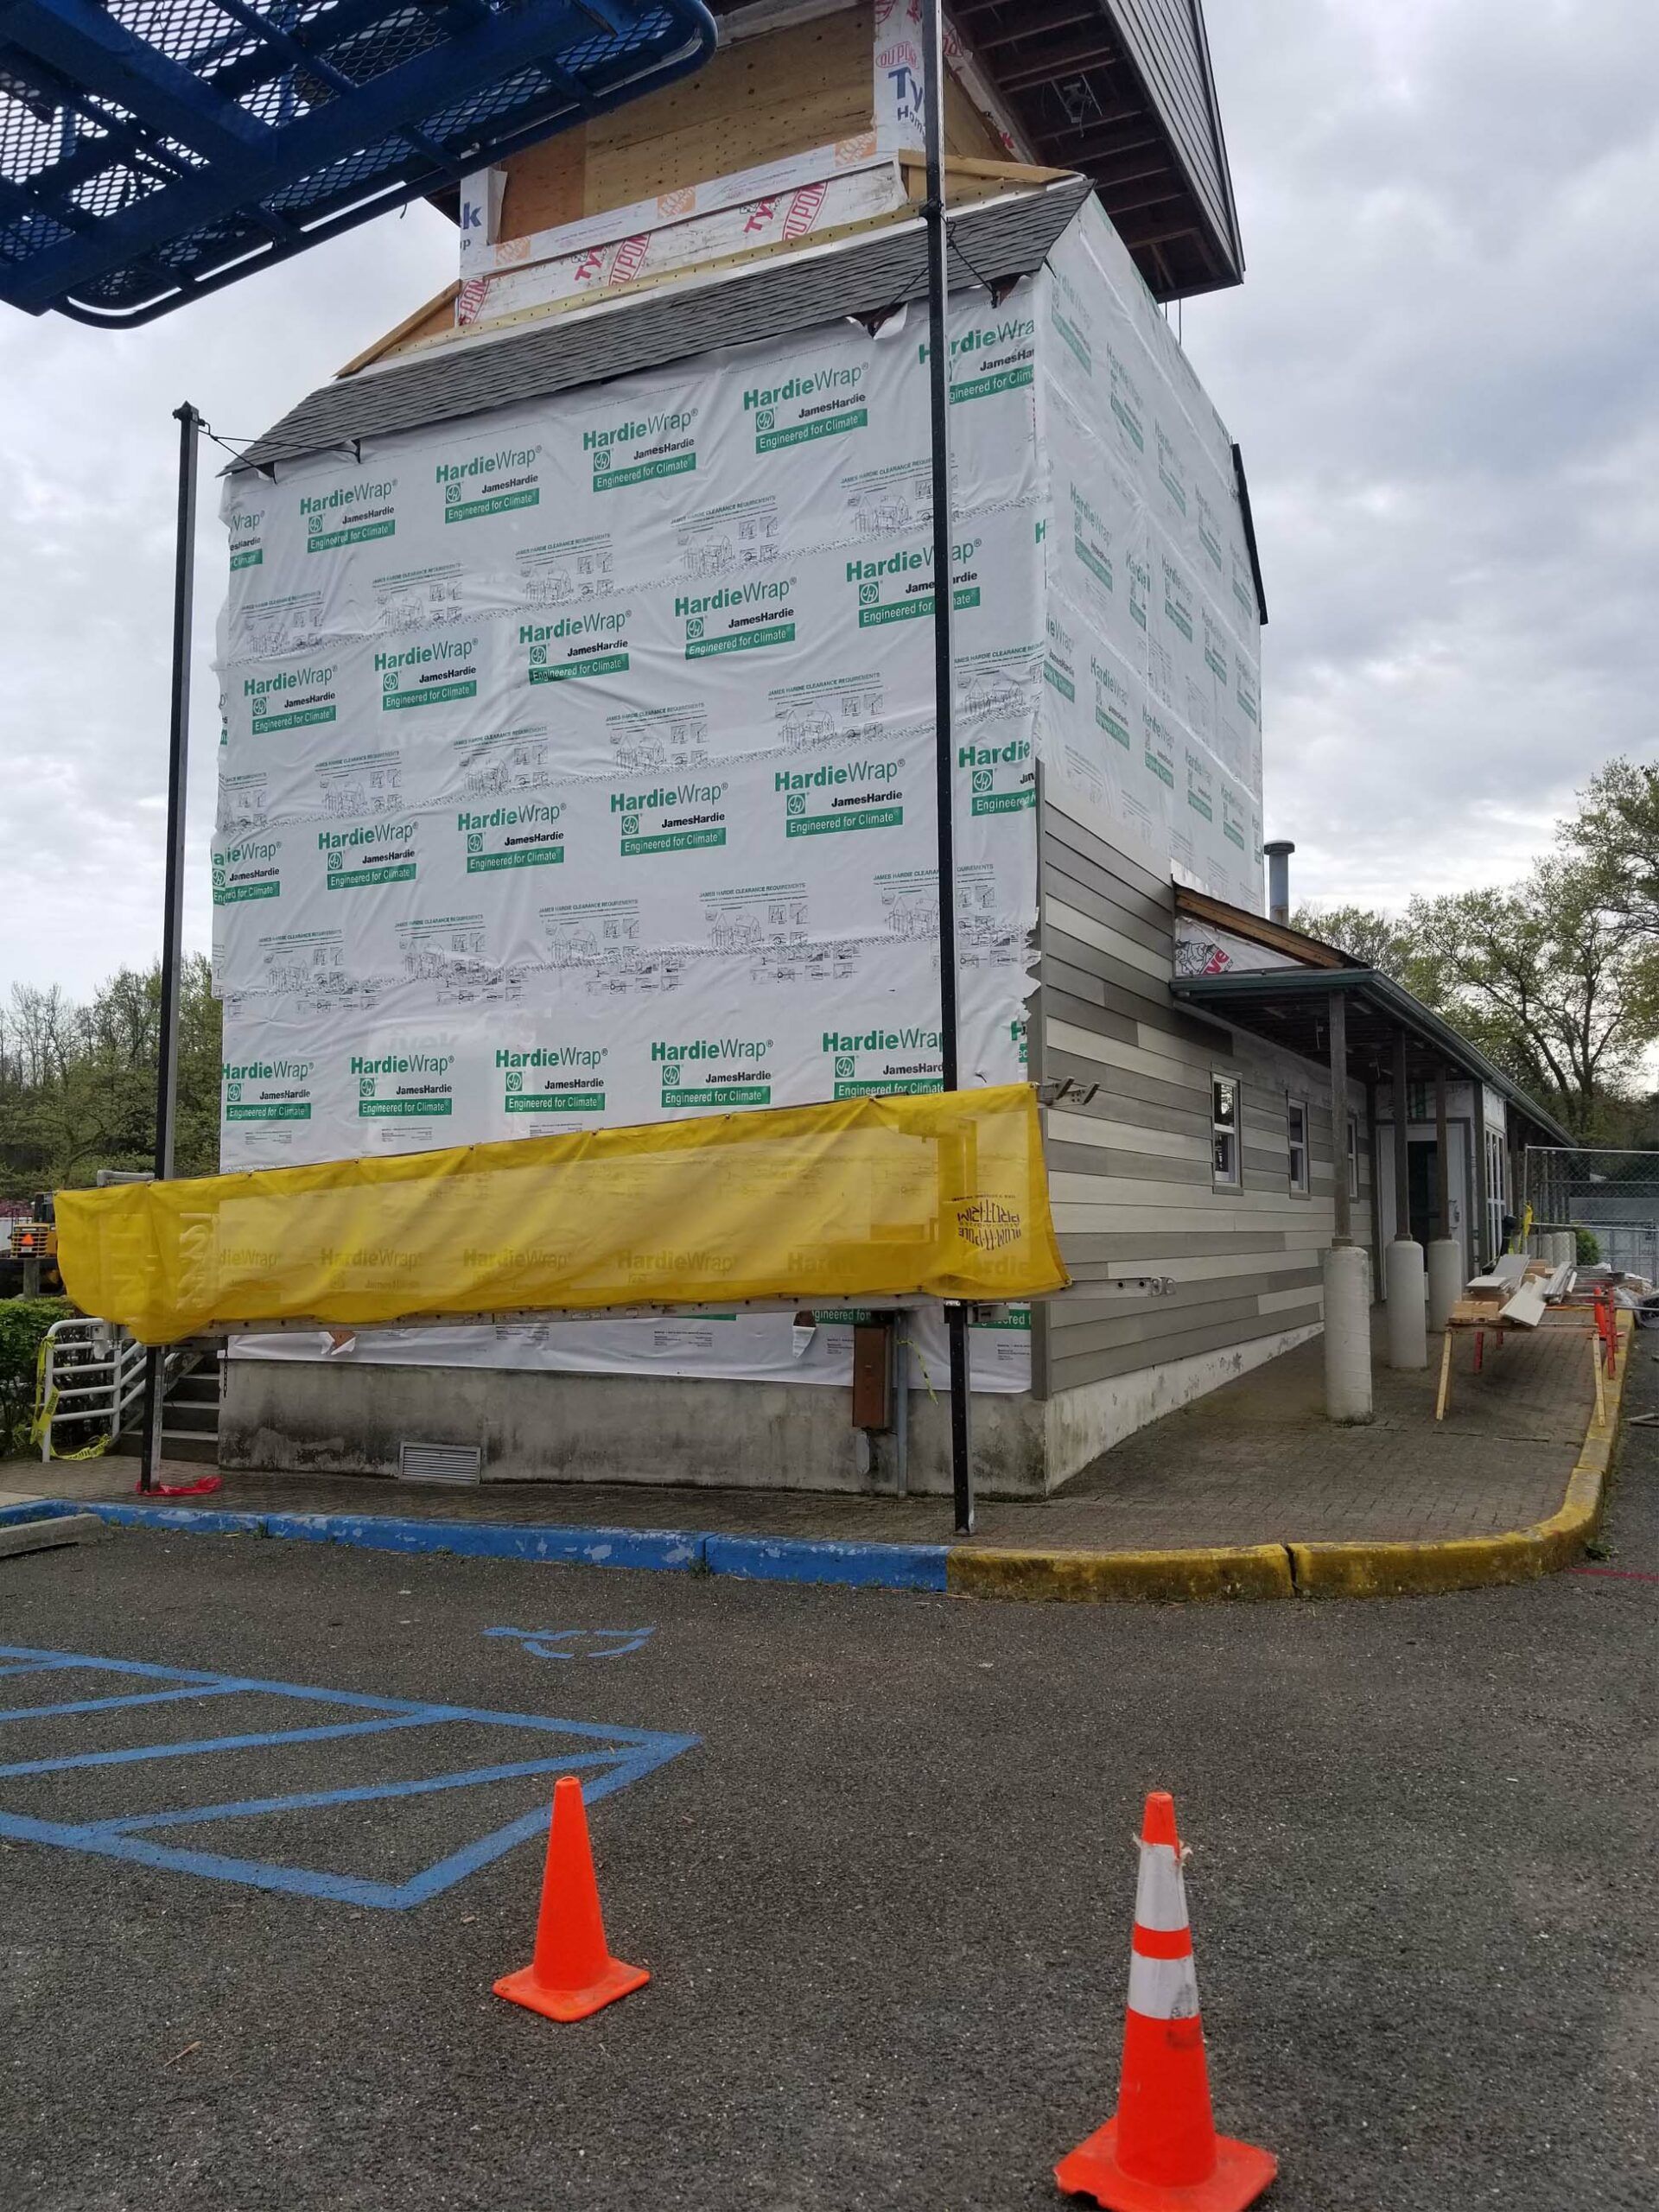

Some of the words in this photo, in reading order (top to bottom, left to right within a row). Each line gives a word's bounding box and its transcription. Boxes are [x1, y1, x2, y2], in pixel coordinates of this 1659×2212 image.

[918, 320, 1034, 365] HrdieWra
[950, 382, 990, 403] gineered
[994, 378, 1007, 390] for
[798, 392, 865, 418] JamesHardie
[760, 427, 808, 448] Engineered
[810, 425, 823, 435] for
[633, 437, 695, 460] JamesHardie
[481, 473, 538, 494] JamesHardie
[597, 468, 641, 487] Engineered
[643, 467, 654, 477] for
[342, 505, 395, 525] JamesHardie
[448, 501, 489, 520] Engineered
[491, 500, 501, 511] for
[310, 532, 348, 549] Engineered
[350, 531, 359, 540] for
[728, 607, 794, 628] JamesHardie
[864, 602, 916, 623] Engineered
[918, 601, 932, 612] for
[567, 639, 628, 658] JamesHardie
[689, 637, 736, 656] Engineered
[739, 636, 751, 646] for
[992, 646, 1027, 658] CLEARANCE
[419, 665, 477, 683] JamesHardie
[531, 664, 575, 681] Engineered
[577, 664, 588, 674] for
[284, 691, 335, 709] JamesHardie
[385, 691, 426, 708] Engineered
[429, 690, 438, 700] for
[255, 716, 291, 732] Engineered
[293, 715, 302, 725] for
[831, 789, 903, 807] JamesHardie
[661, 811, 725, 828] JamesHardie
[790, 817, 841, 834] Engineered
[843, 816, 856, 827] for
[504, 830, 564, 846] JamesHardie
[625, 837, 670, 853] Engineered
[672, 837, 683, 847] for
[362, 849, 415, 864] JamesHardie
[470, 855, 512, 870] Engineered
[515, 855, 525, 864] for
[229, 867, 280, 881] JamesHardie
[330, 872, 369, 887] Engineered
[371, 872, 380, 881] for
[238, 888, 247, 897] for
[735, 886, 764, 894] CLEARANCE
[544, 1077, 604, 1089] JamesHardie
[705, 1070, 772, 1084] JamesHardie
[259, 1089, 311, 1100] JamesHardie
[396, 1084, 452, 1095] JamesHardie
[665, 1090, 713, 1105] Engineered
[715, 1090, 727, 1102] for
[838, 1084, 892, 1097] Engineered
[362, 1102, 403, 1115] Engineered
[404, 1102, 415, 1112] for
[508, 1097, 551, 1111] Engineered
[554, 1097, 565, 1108] for
[229, 1107, 266, 1119] Engineered
[268, 1107, 277, 1116] for
